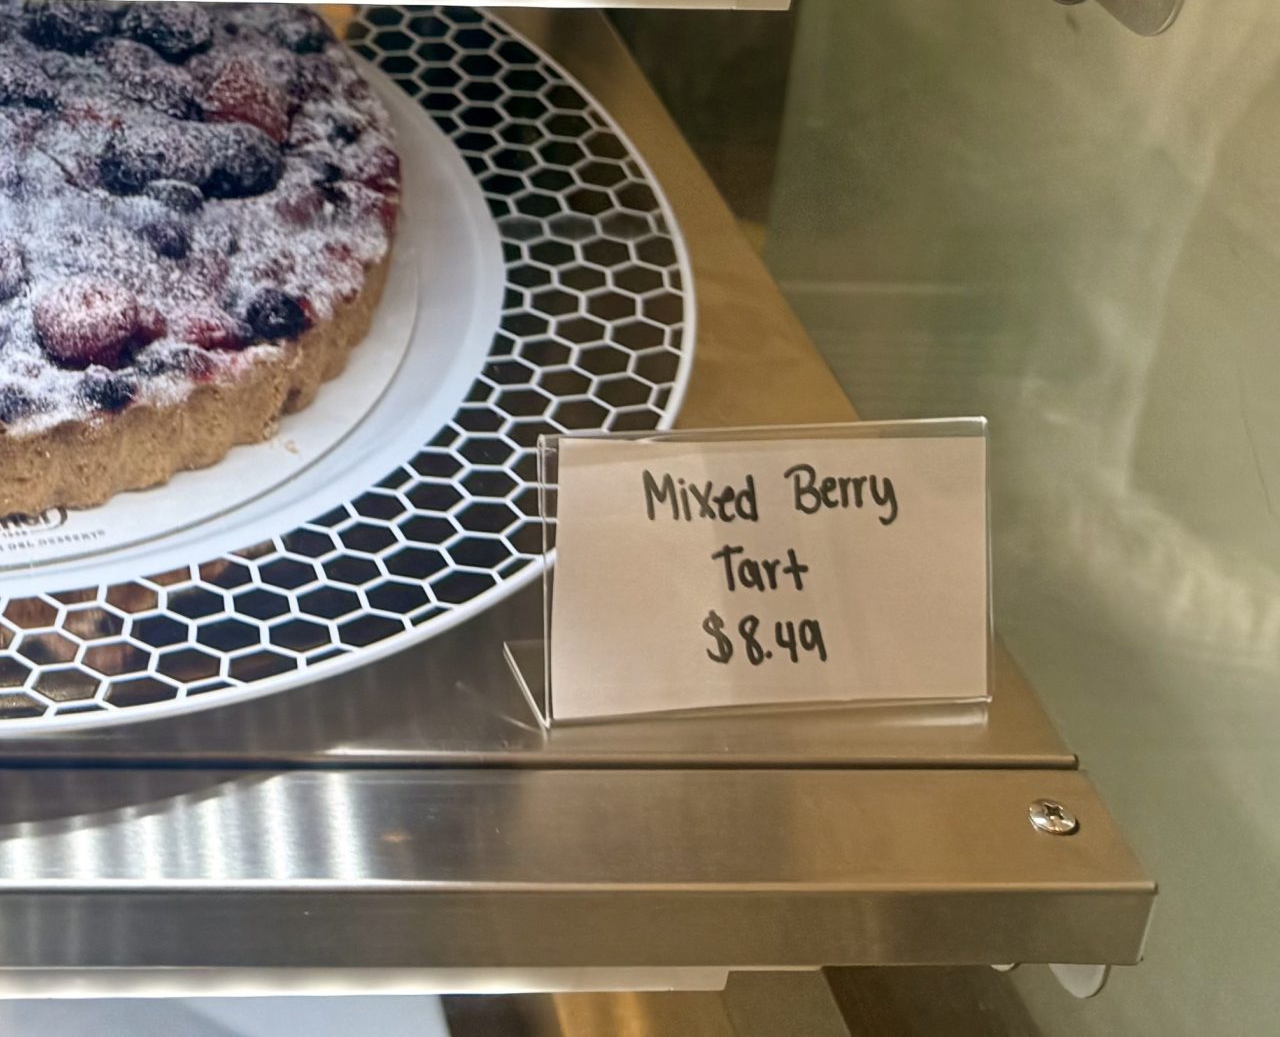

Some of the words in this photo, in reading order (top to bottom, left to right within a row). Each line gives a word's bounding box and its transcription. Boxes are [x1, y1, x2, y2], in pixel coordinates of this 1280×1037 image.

[642, 469, 758, 522] Mixed
[784, 464, 898, 525] Berry
[711, 544, 809, 592] Tart
[702, 610, 828, 666] $8.49
